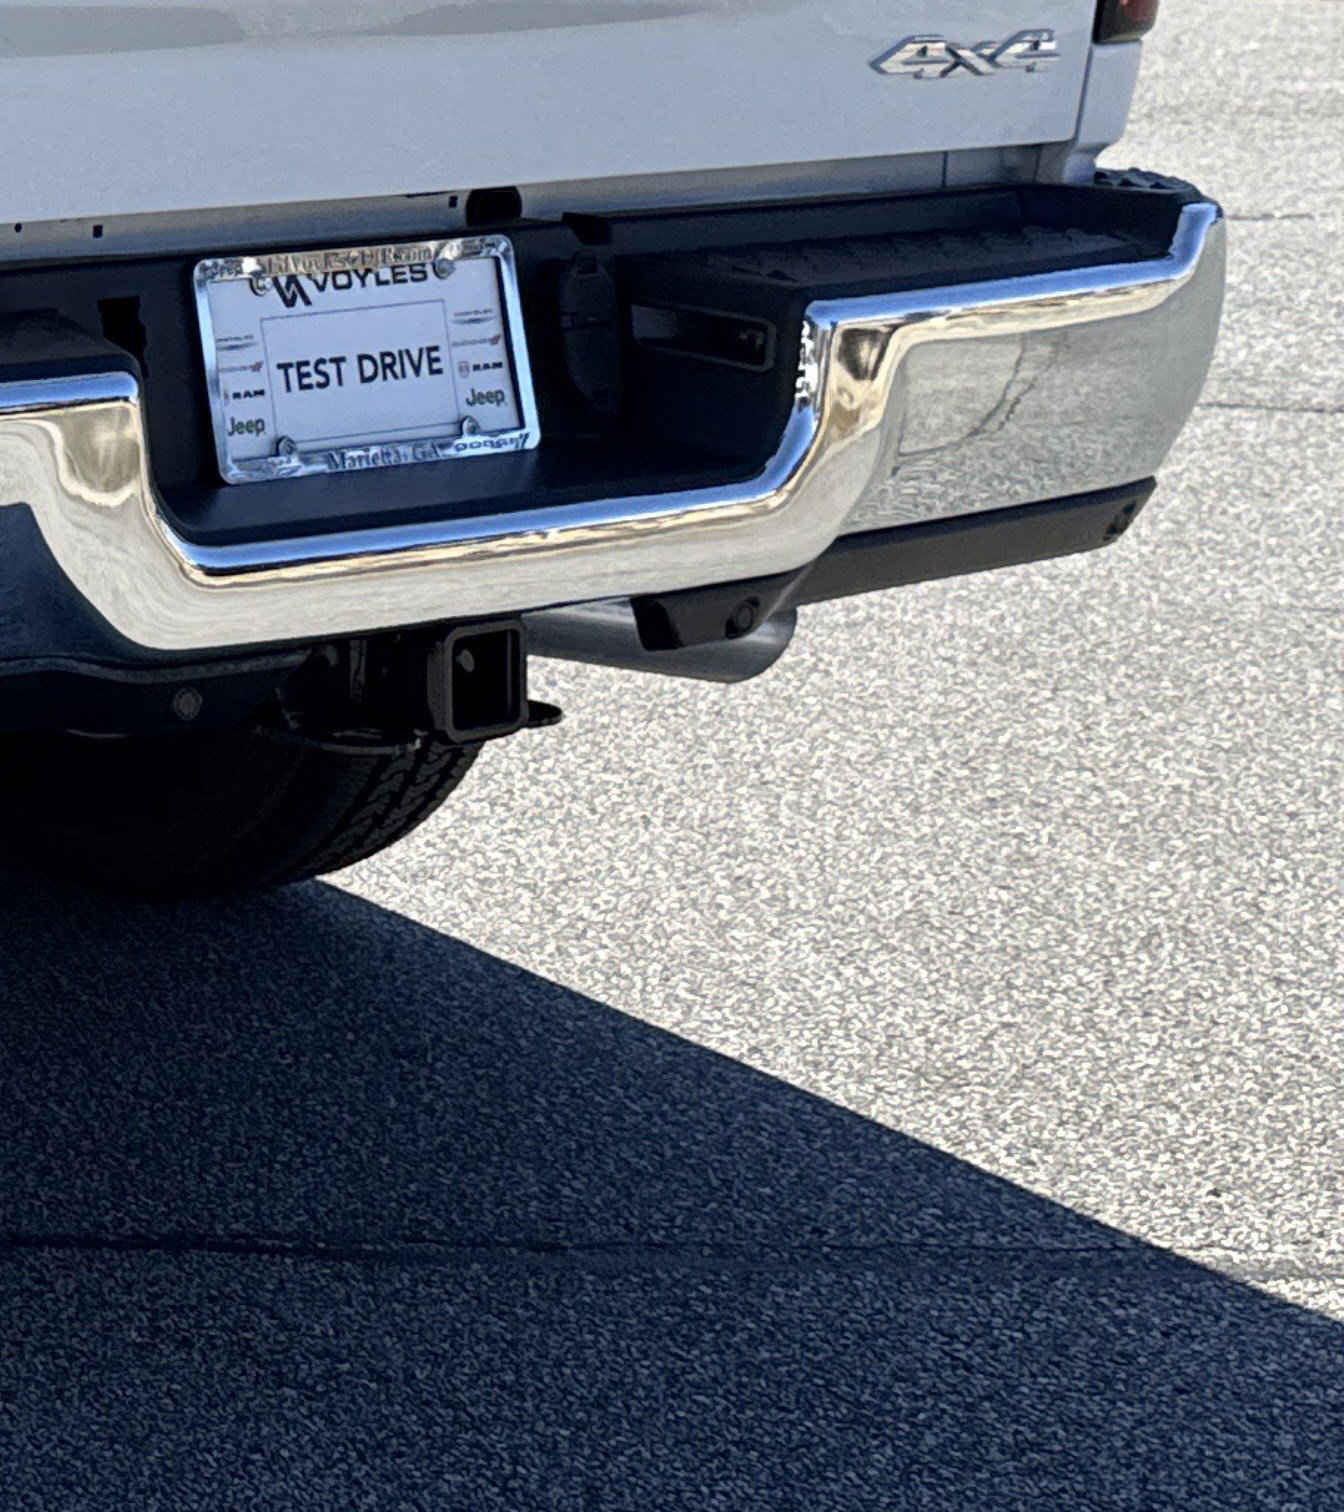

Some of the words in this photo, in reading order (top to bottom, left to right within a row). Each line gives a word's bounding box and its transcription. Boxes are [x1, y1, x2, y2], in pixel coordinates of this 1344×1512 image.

[310, 263, 428, 292] VOYLES
[276, 355, 347, 394] TEST
[357, 345, 445, 385] DRIVE
[465, 388, 506, 407] Jeep
[227, 416, 266, 437] Jeep
